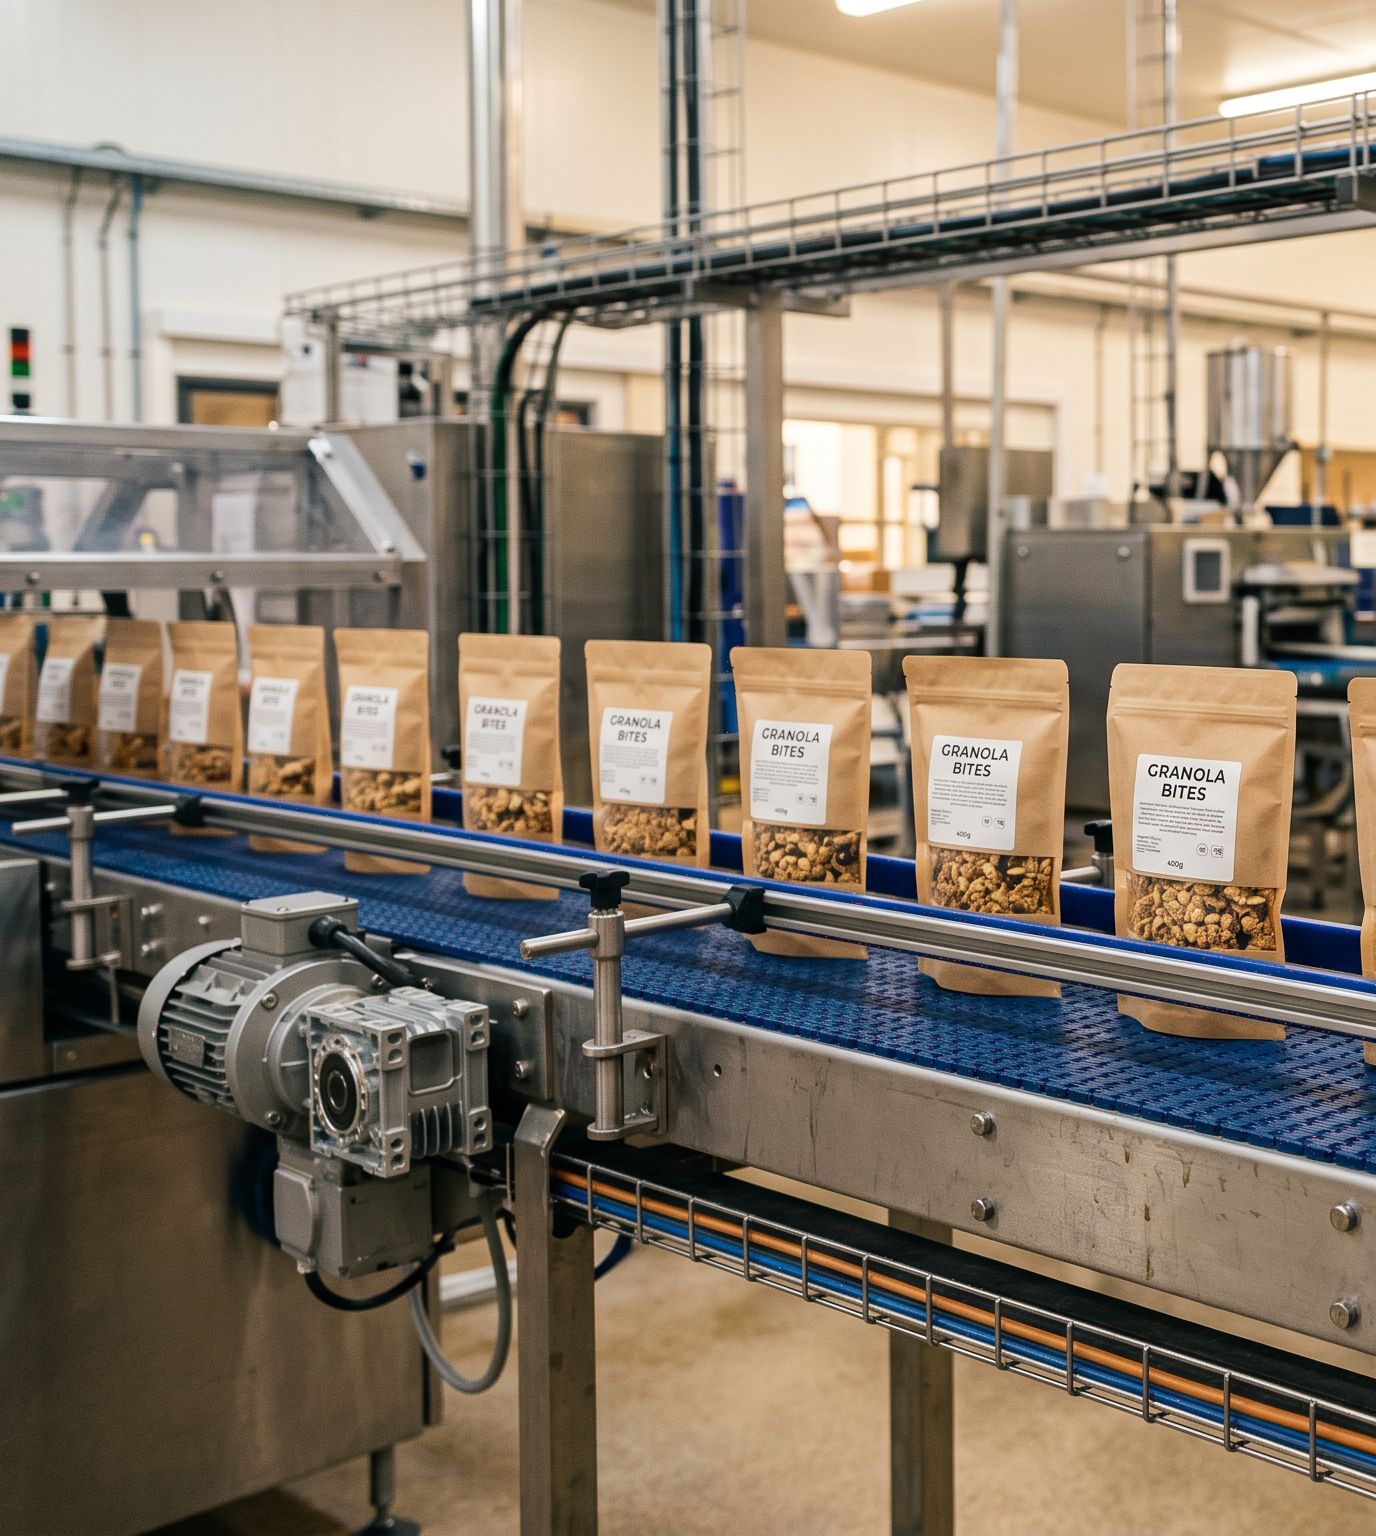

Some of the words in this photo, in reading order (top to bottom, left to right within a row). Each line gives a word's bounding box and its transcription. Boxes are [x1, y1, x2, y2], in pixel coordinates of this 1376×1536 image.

[610, 715, 660, 729] GRANOLA
[617, 730, 647, 743] BITES
[762, 728, 819, 743] GRANOLA
[771, 744, 805, 758] BITES
[942, 744, 1008, 761] GRANOLA
[953, 762, 991, 777] BITES
[1148, 764, 1225, 784] GRANOLA
[1161, 783, 1206, 801] BITES
[1167, 860, 1183, 870] 400g
